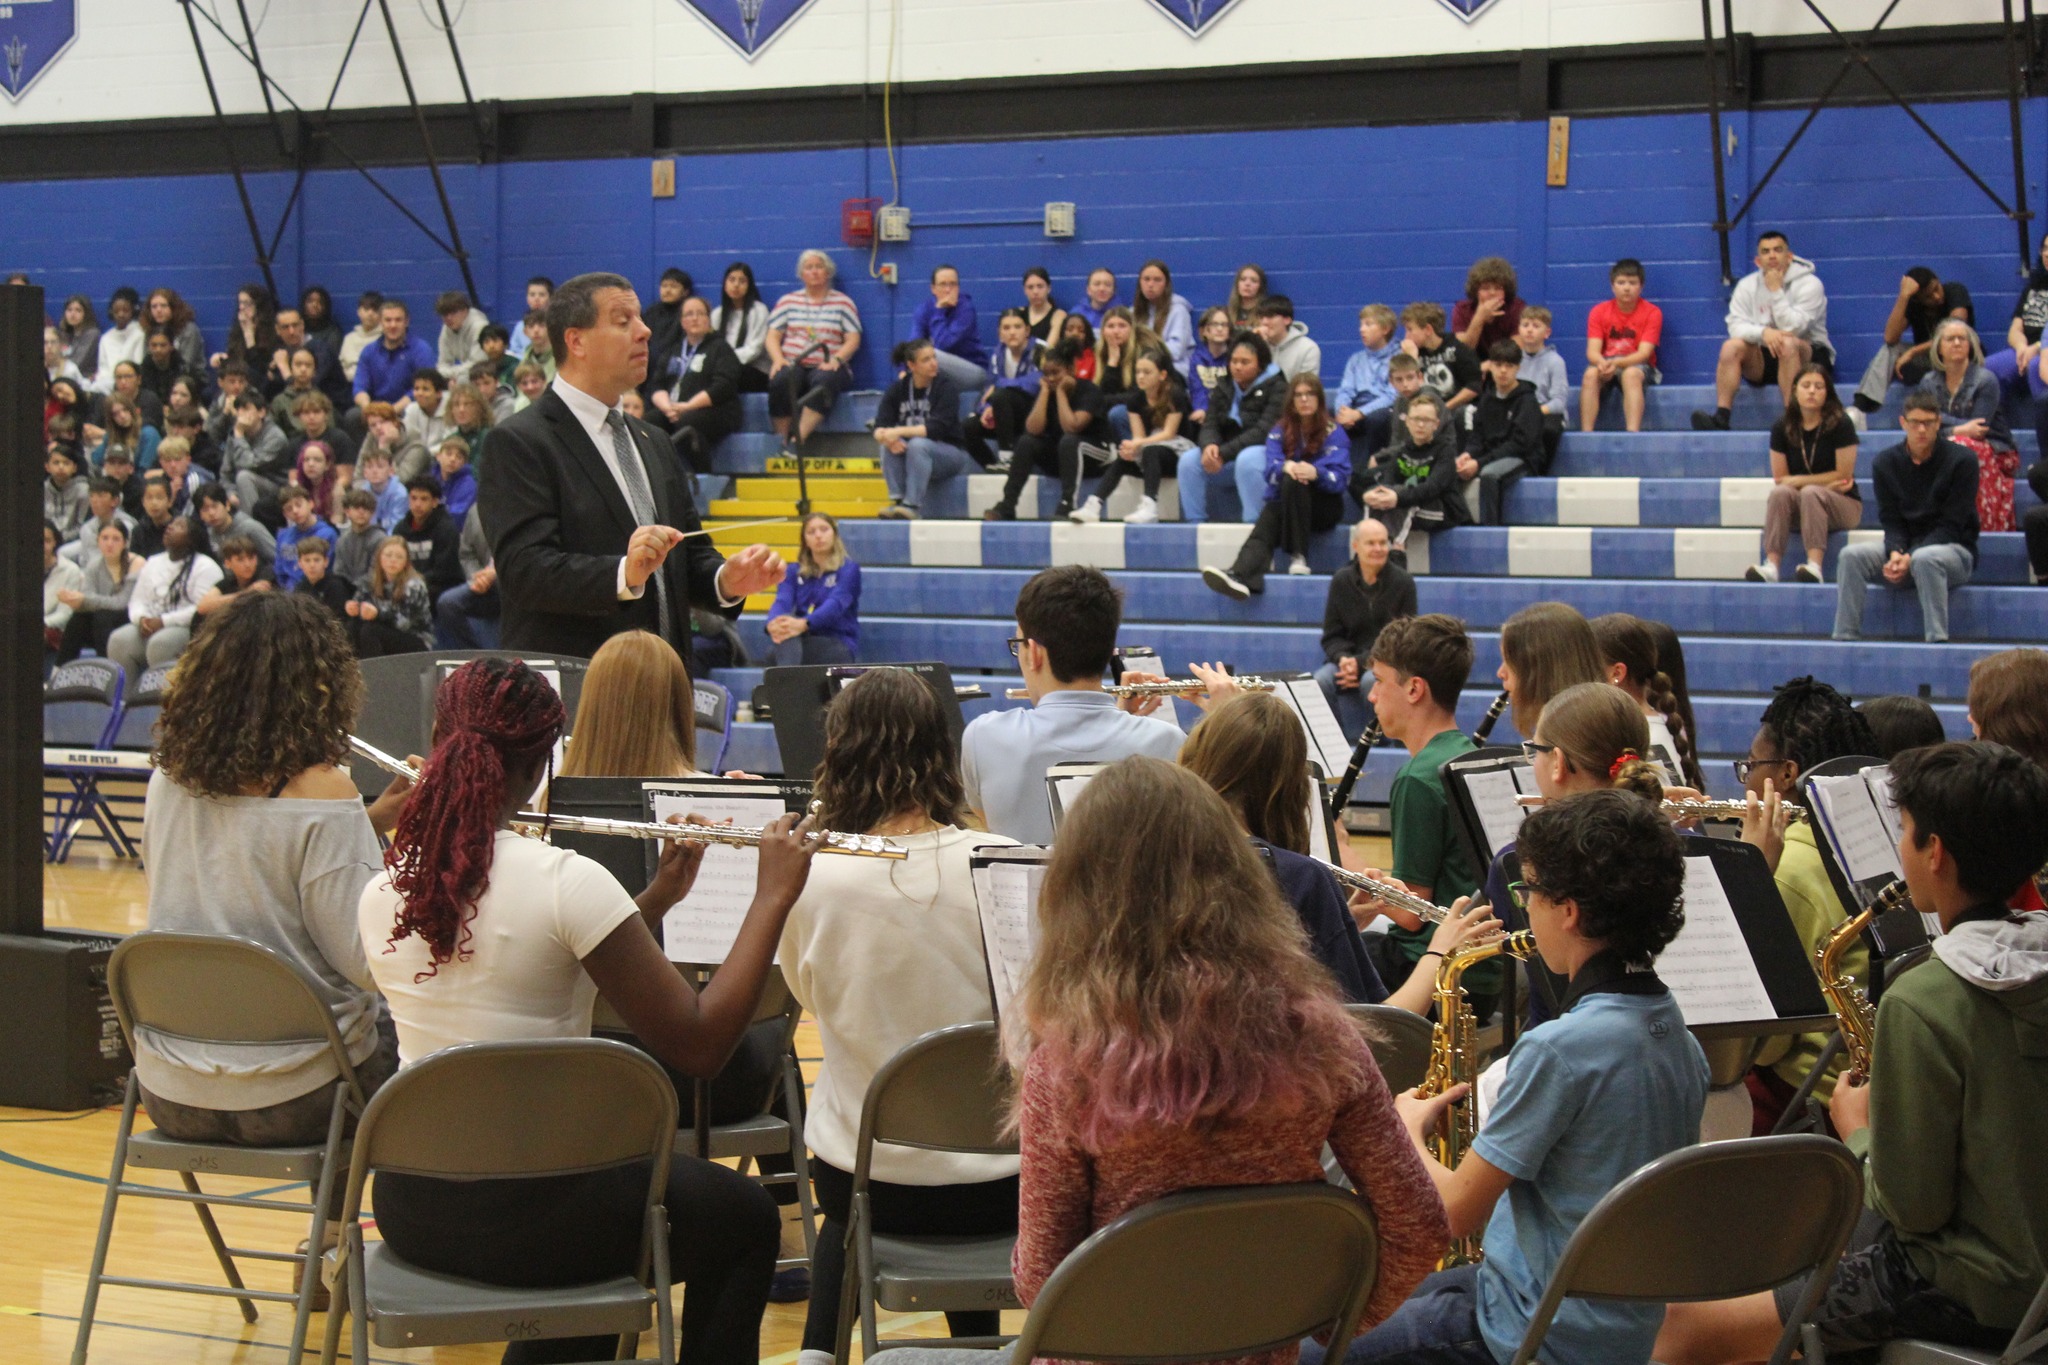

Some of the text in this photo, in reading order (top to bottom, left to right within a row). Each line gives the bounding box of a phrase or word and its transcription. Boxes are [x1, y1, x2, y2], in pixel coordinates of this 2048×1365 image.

[784, 460, 832, 469] KEP OFF
[505, 1319, 541, 1338] OMS
